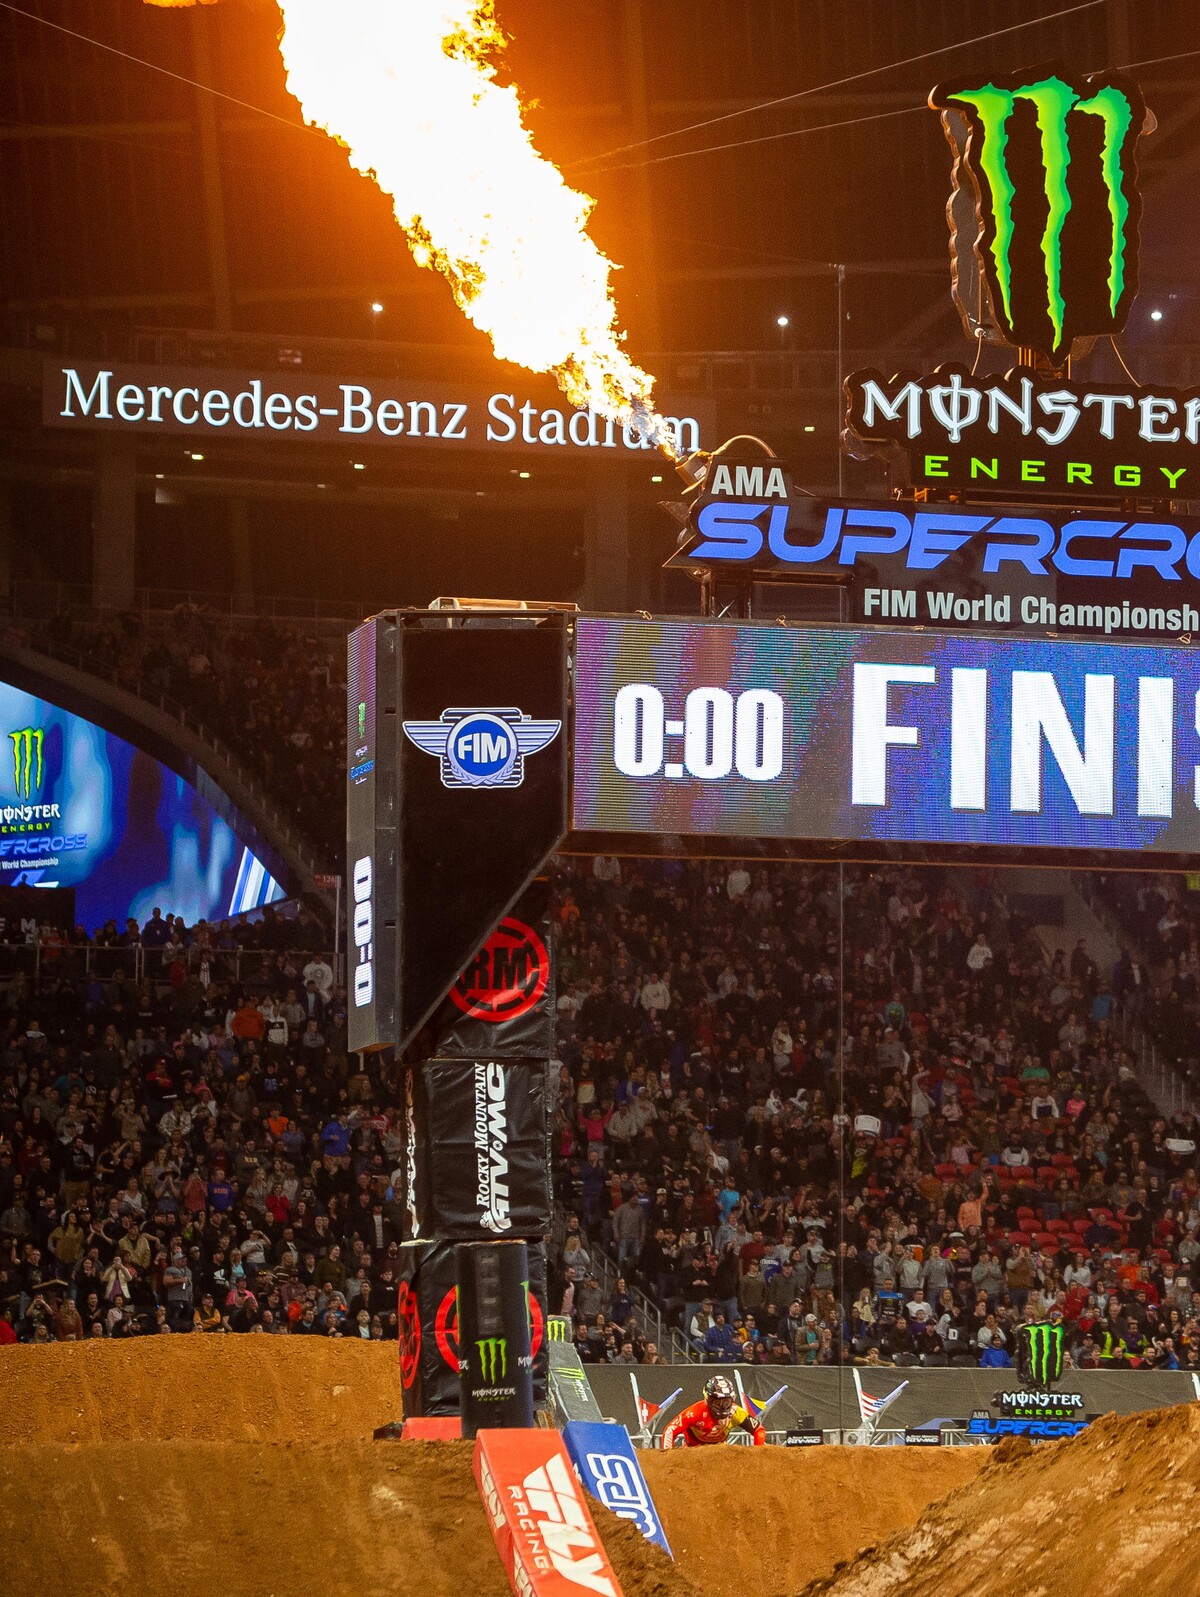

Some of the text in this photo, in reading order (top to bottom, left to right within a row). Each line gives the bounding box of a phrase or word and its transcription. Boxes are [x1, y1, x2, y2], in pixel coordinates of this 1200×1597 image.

[60, 368, 467, 439] Mercedes-Benz
[711, 465, 788, 499] AMA
[925, 455, 1187, 489] ENERGY
[864, 588, 917, 618] FIM
[926, 591, 1011, 623] World
[458, 732, 507, 763] FIM
[613, 683, 785, 782] 0:00
[1, 822, 51, 833] ENERGY
[474, 1062, 491, 1208] ROCKY MOUNTAIN
[972, 1411, 990, 1419] AMA
[1002, 1391, 1083, 1407] MONSTER
[1014, 1408, 1074, 1416] ENERGY
[506, 1484, 550, 1573] RACING
